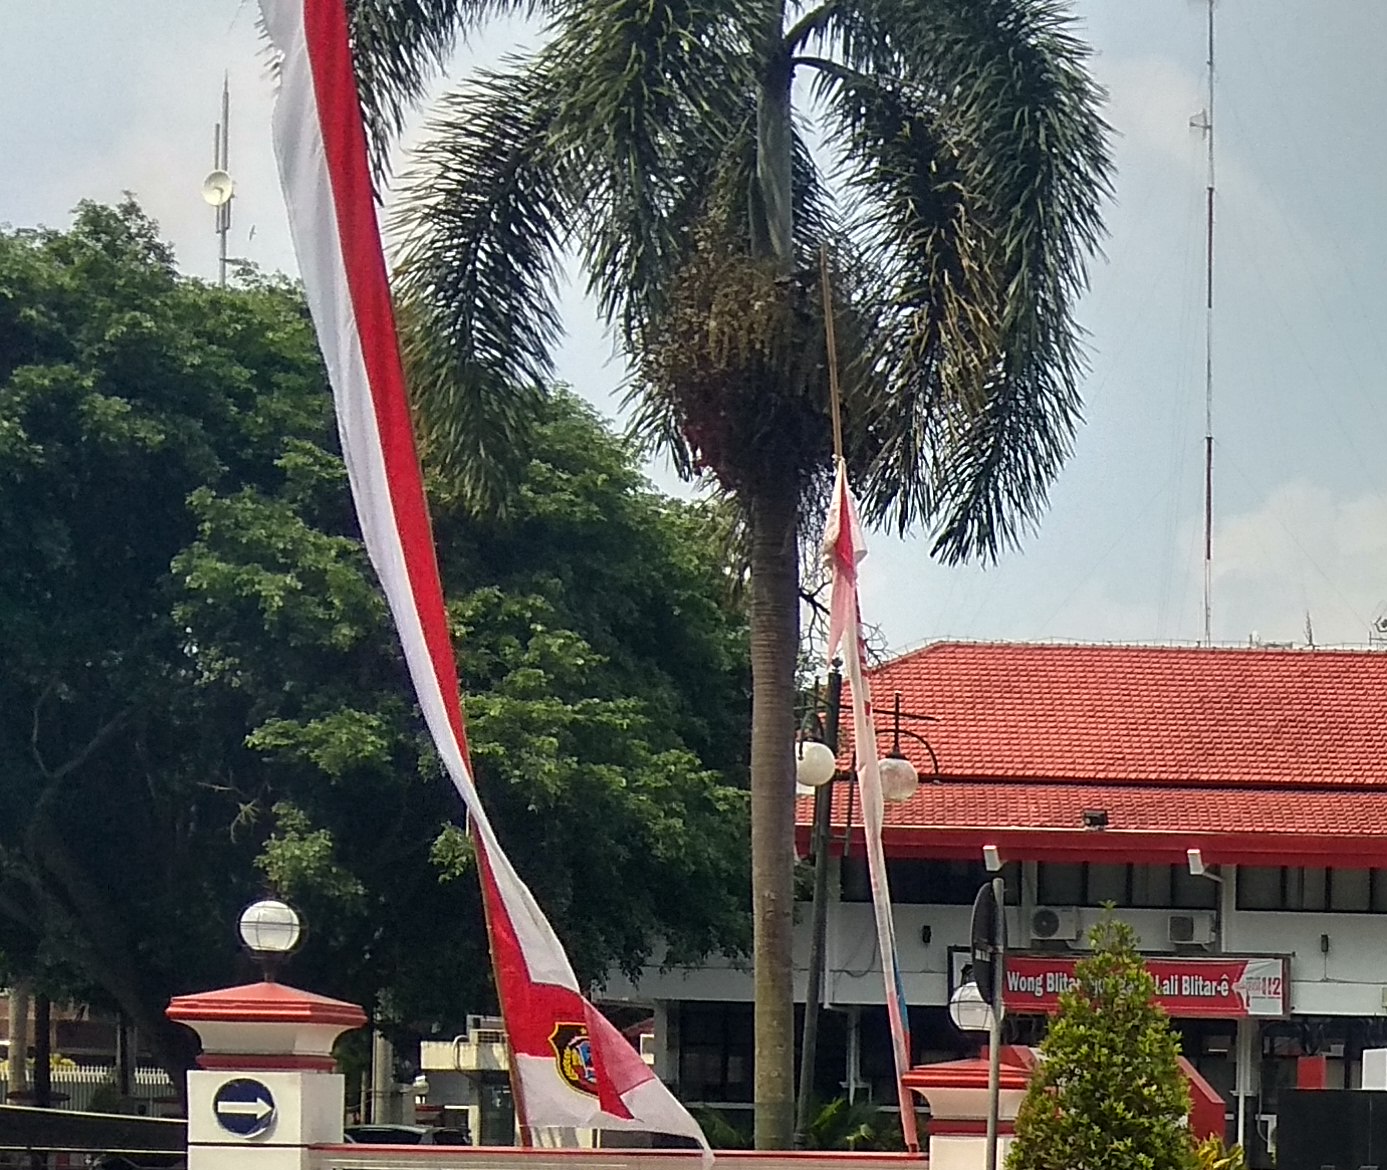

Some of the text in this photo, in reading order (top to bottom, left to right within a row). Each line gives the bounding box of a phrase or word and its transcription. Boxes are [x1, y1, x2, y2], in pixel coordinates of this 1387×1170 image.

[1007, 970, 1043, 998] Wong
[1156, 975, 1178, 995] Lali
[1182, 973, 1229, 997] Blitar-ê
